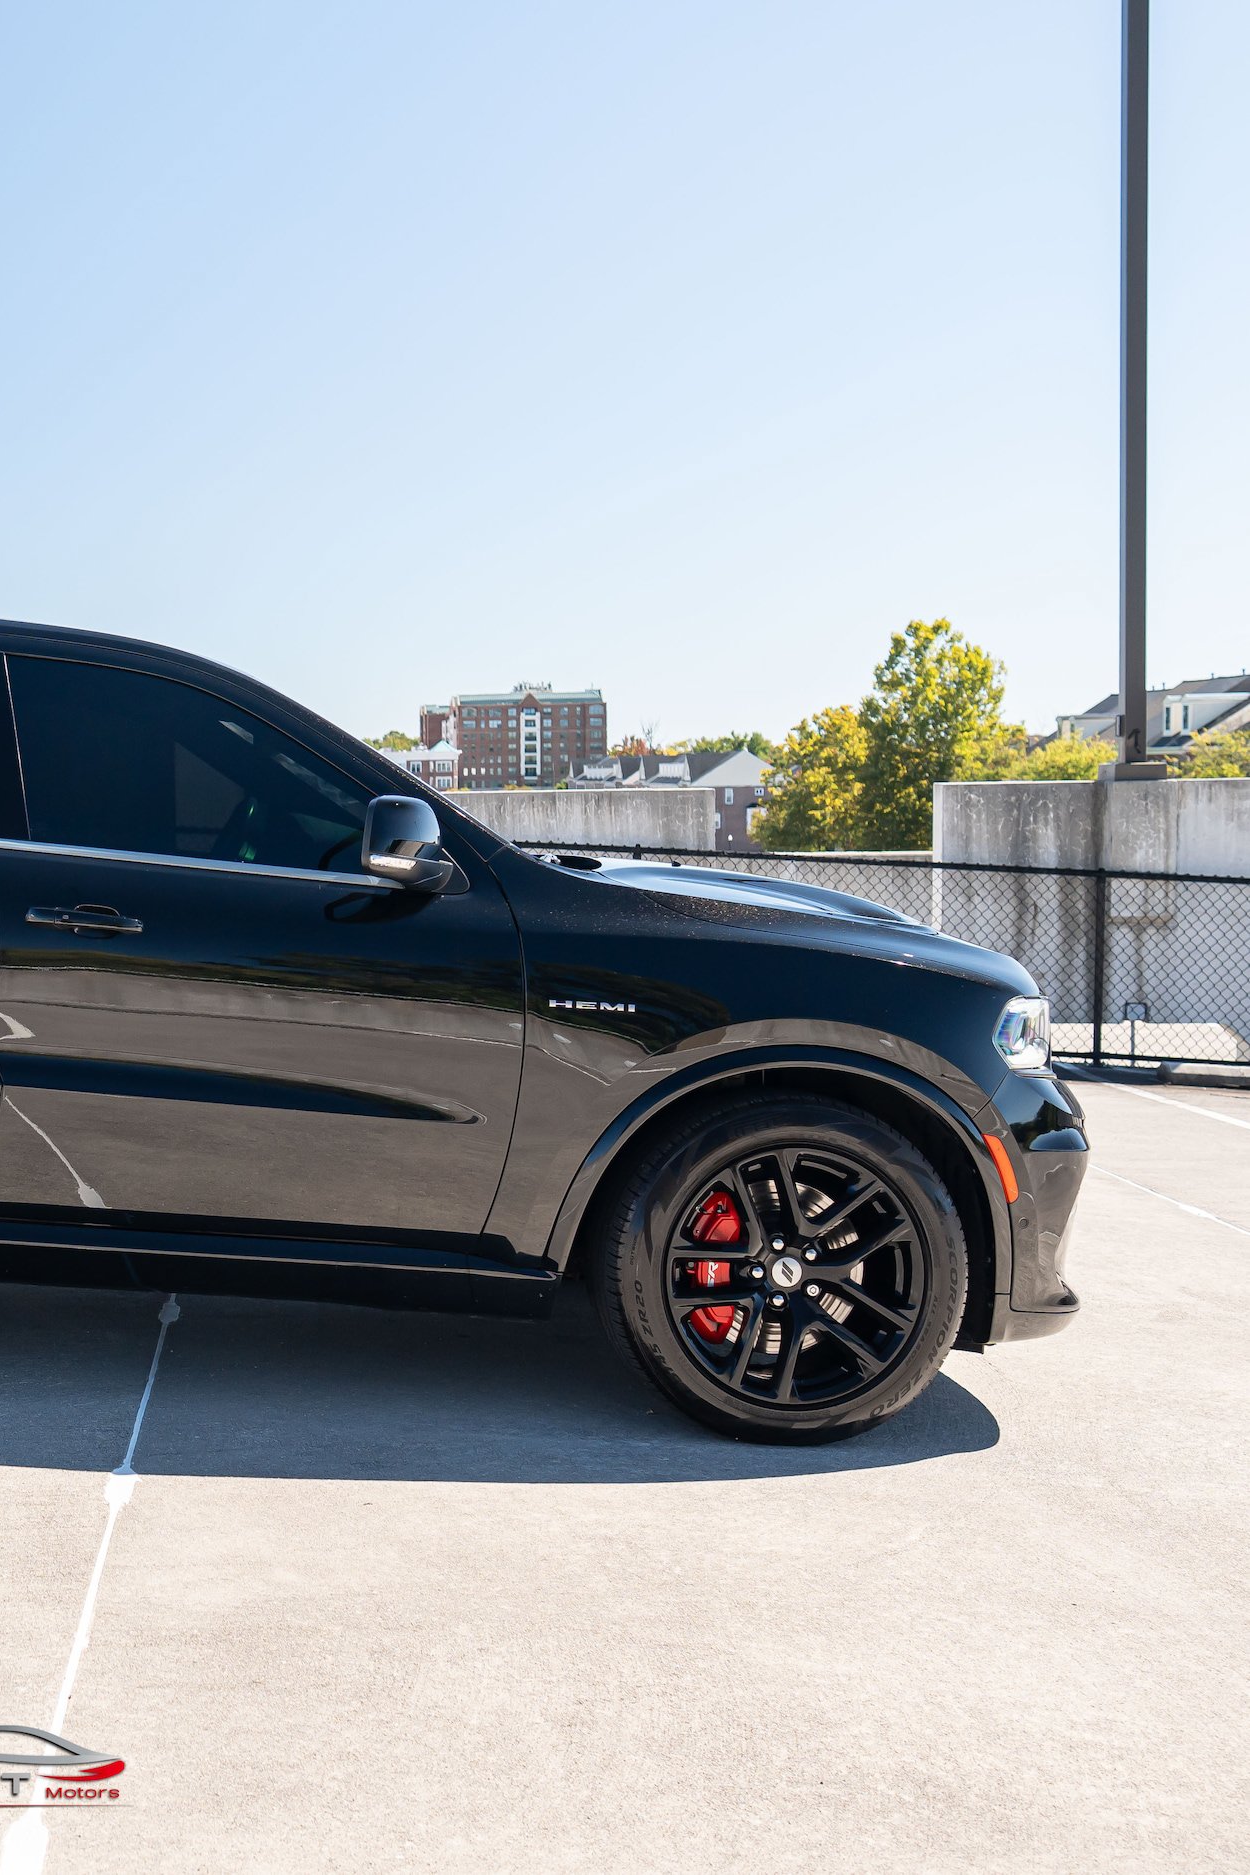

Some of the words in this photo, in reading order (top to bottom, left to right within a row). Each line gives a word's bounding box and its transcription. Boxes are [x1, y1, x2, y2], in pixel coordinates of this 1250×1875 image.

[548, 999, 636, 1013] HEMI
[634, 1279, 654, 1338] ZR20
[928, 1234, 959, 1364] SCORPION
[869, 1367, 922, 1418] ZERO
